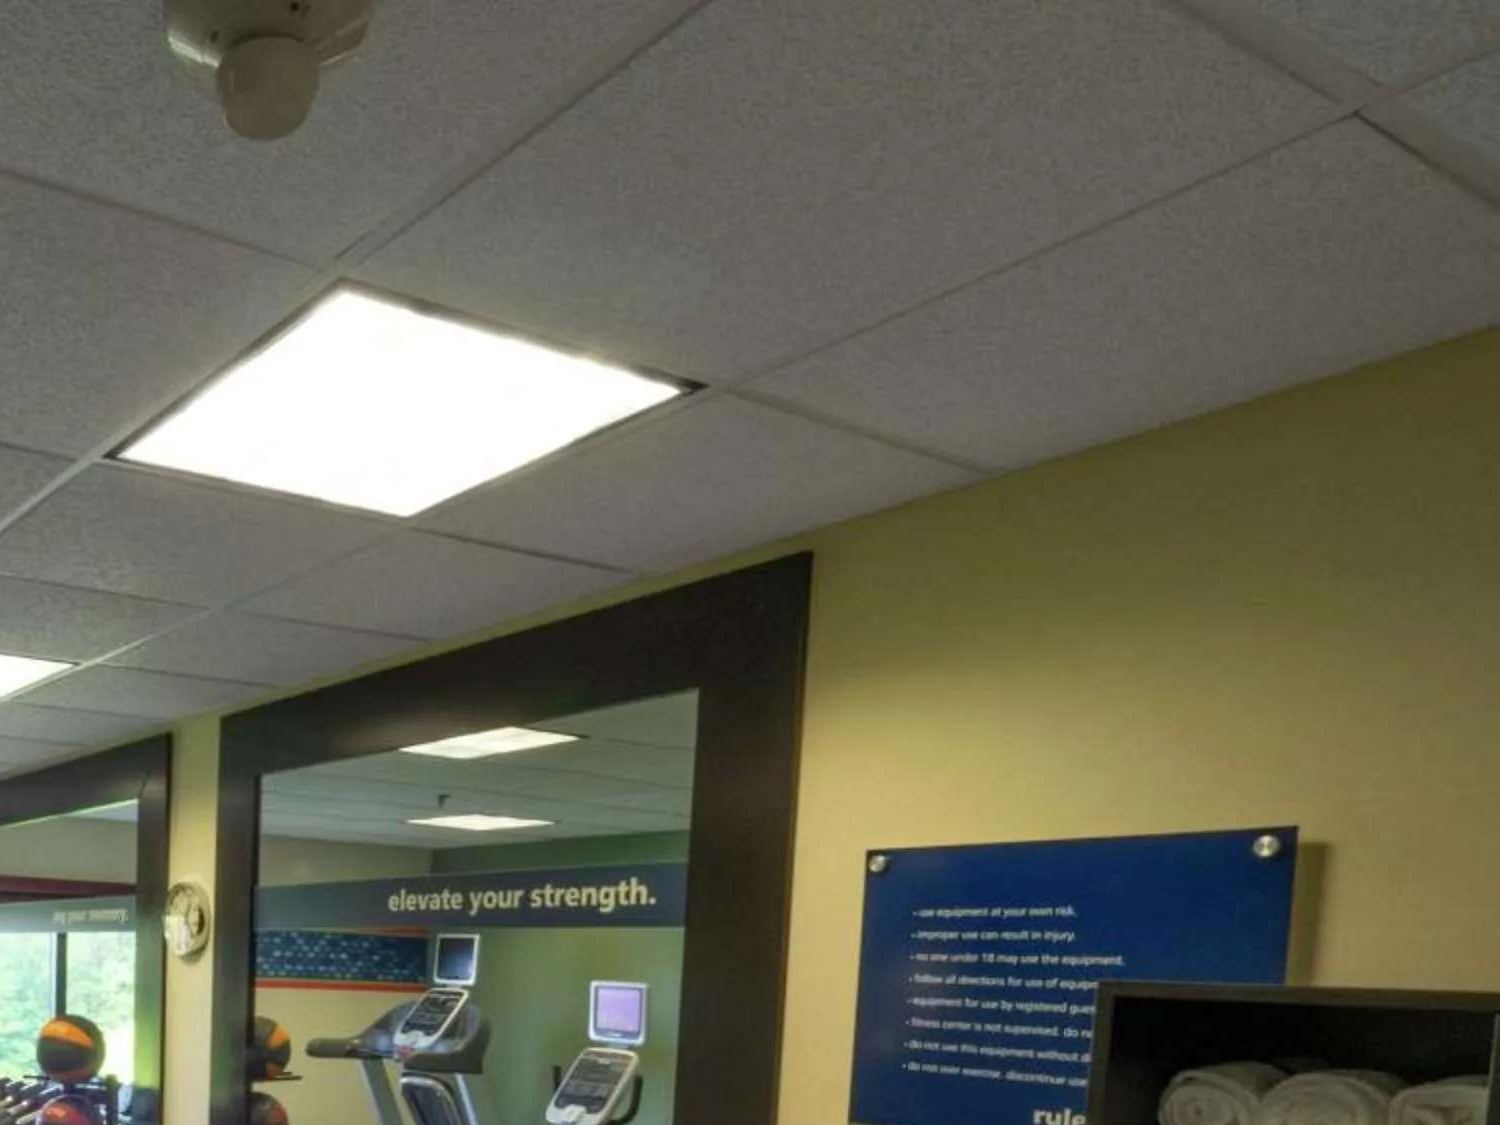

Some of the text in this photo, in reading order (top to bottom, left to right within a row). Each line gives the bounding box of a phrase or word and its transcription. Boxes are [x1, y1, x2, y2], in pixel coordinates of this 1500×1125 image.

[388, 877, 657, 916] elevate your strength.
[936, 908, 988, 919] equipment
[991, 907, 1001, 917] at
[1002, 908, 1026, 919] your
[1028, 907, 1054, 917] own
[1055, 905, 1077, 918] risk.
[917, 930, 1076, 943] improper use can result in injury.
[949, 952, 979, 963] under
[981, 952, 995, 963] 18
[996, 954, 1018, 966] may
[1020, 955, 1039, 964] use
[1041, 954, 1059, 965] the
[1061, 955, 1124, 967] equipment.
[914, 973, 943, 984] follow
[958, 975, 1005, 987] directions
[1007, 976, 1022, 987] for
[1025, 979, 1043, 989] use
[1044, 978, 1059, 989] of
[964, 997, 978, 1008] for
[980, 1000, 999, 1009] use
[1000, 1000, 1013, 1012] by
[1015, 1002, 1067, 1014] registered
[942, 1020, 971, 1031] center
[984, 1023, 1002, 1033] not
[1063, 1027, 1079, 1038] do
[909, 1039, 923, 1049] do
[923, 1041, 940, 1051] not
[941, 1043, 959, 1052] use
[960, 1043, 978, 1053] this
[979, 1046, 1034, 1059] equipment
[1036, 1050, 1079, 1062] without
[907, 1060, 921, 1071] do
[921, 1063, 939, 1073] not
[940, 1065, 961, 1075] over
[1005, 1070, 1065, 1085] discontinue
